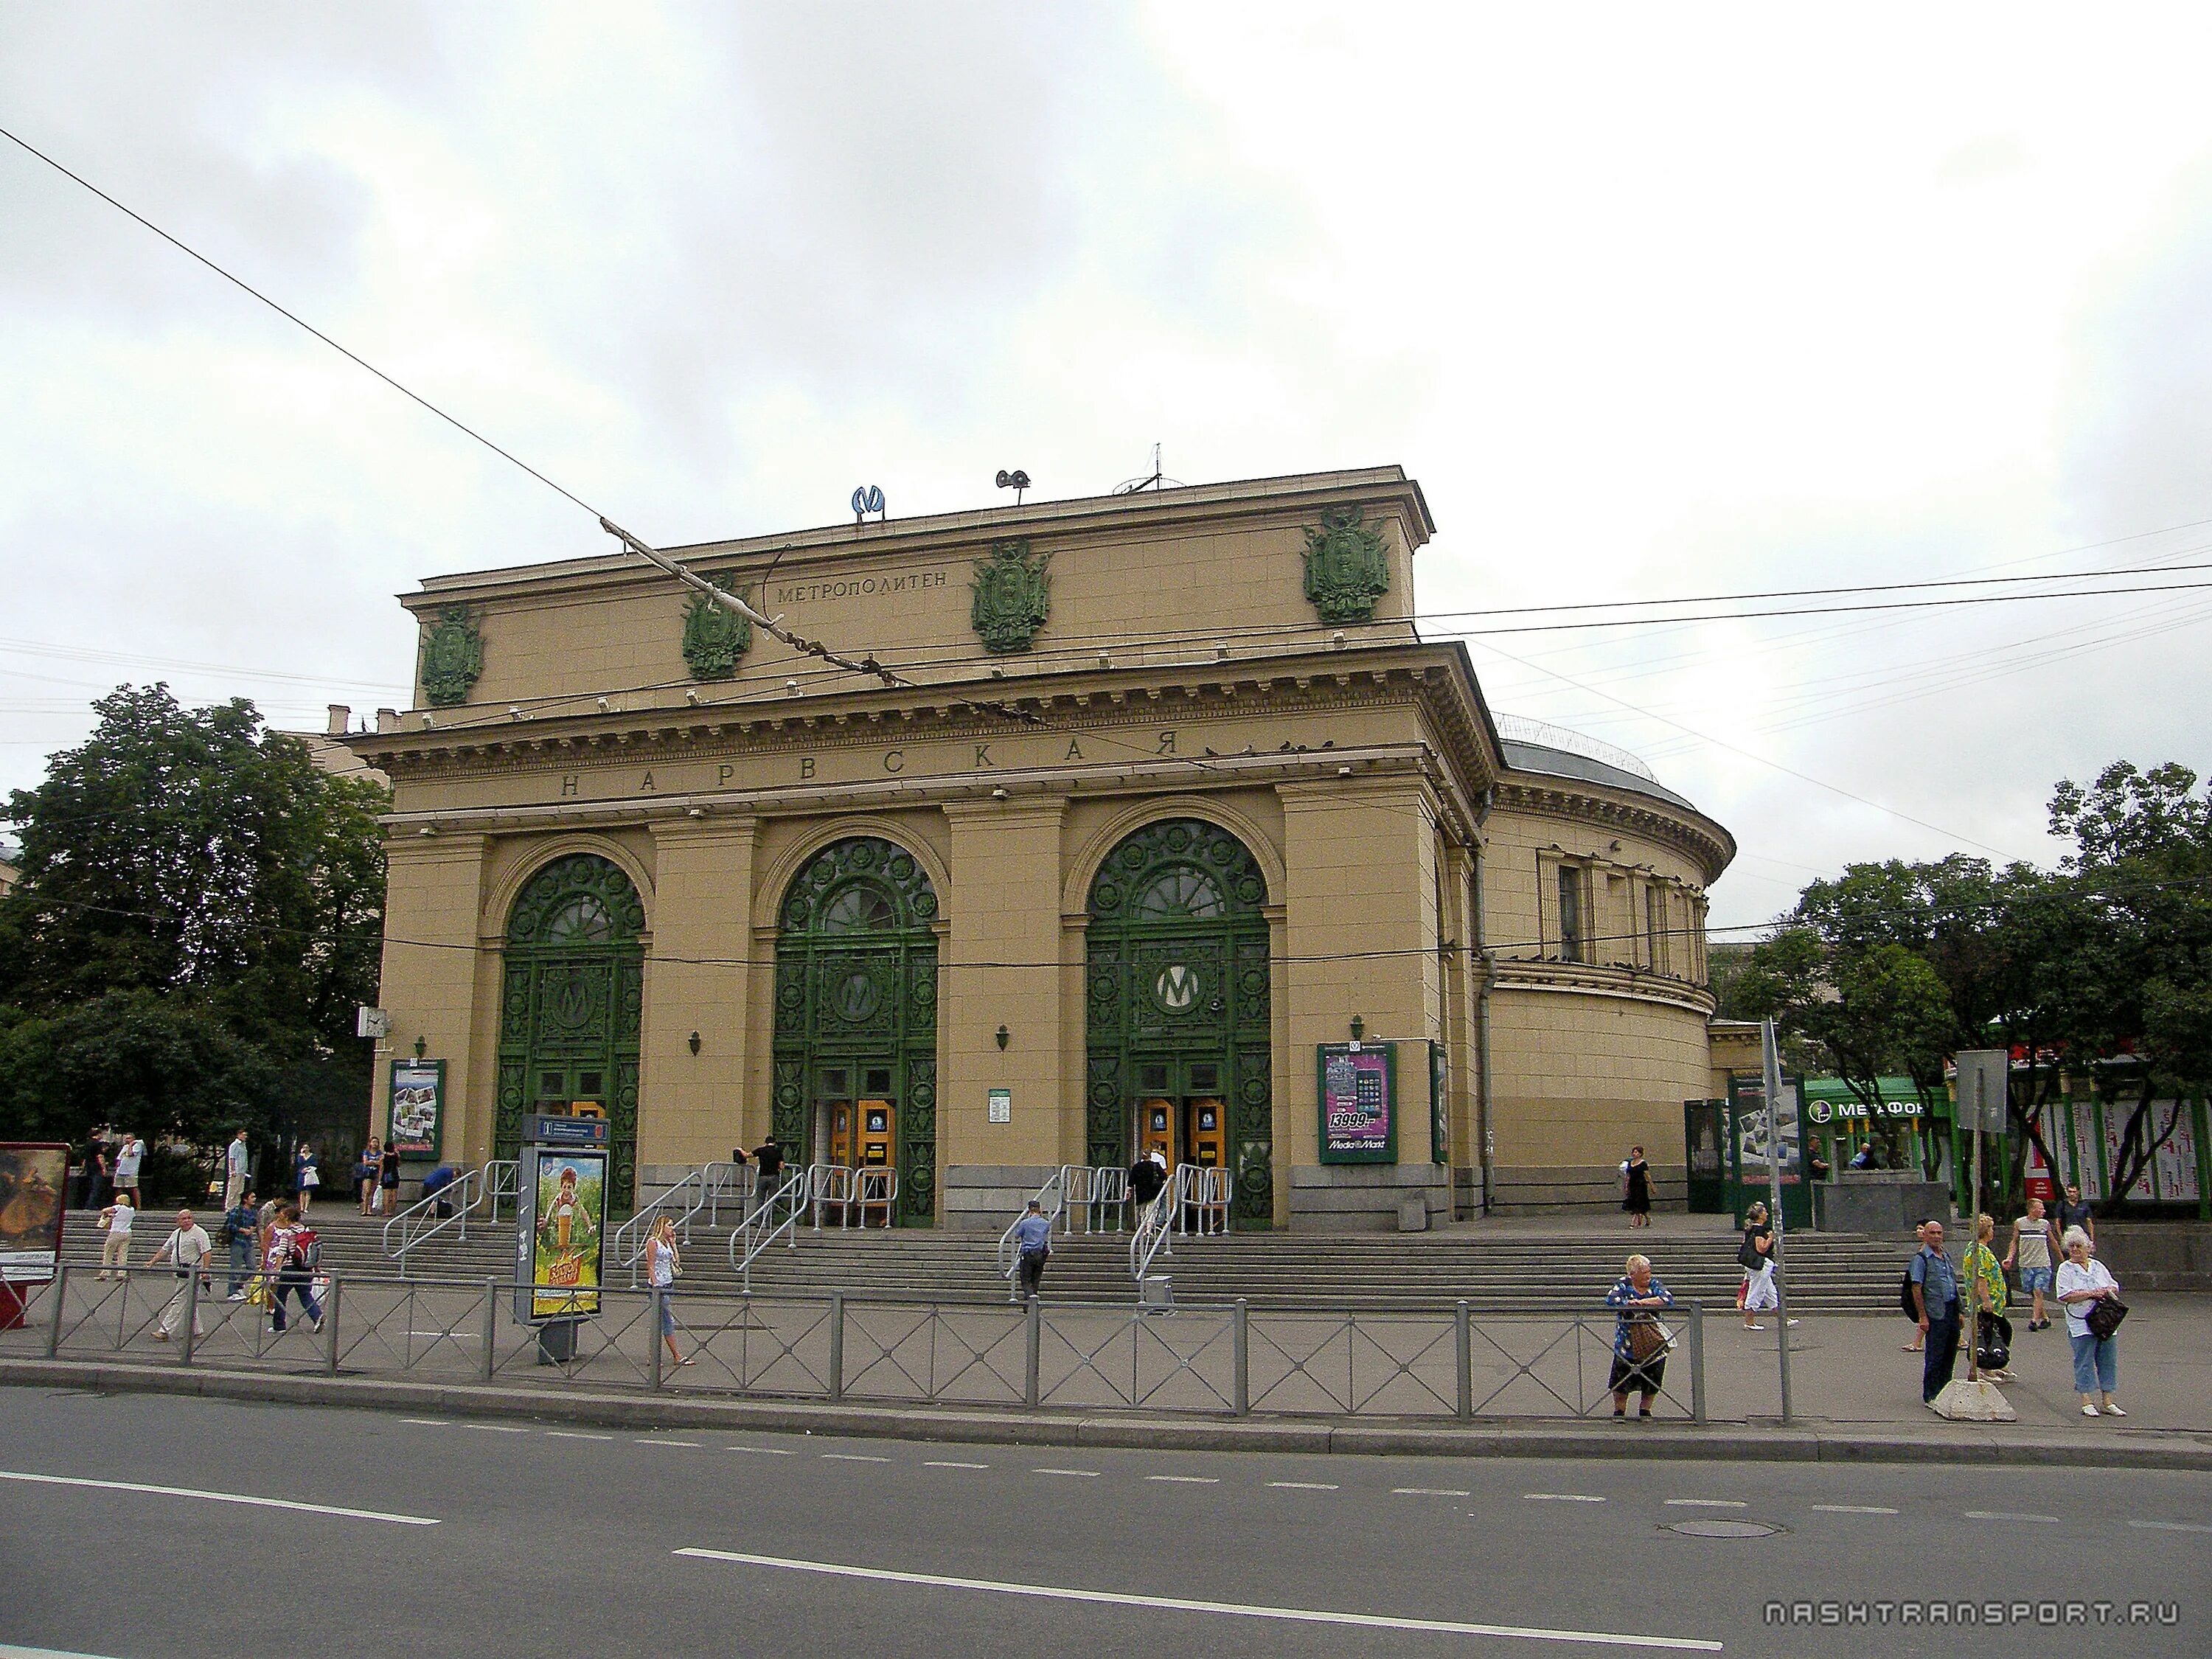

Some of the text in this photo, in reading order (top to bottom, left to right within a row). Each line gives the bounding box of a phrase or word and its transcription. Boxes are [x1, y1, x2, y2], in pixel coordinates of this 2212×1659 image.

[778, 572, 947, 603] МЕТРОПОЛИТЕН
[563, 733, 1177, 796] НАРВСКАЯ
[1329, 1140, 1385, 1150] Media Markt
